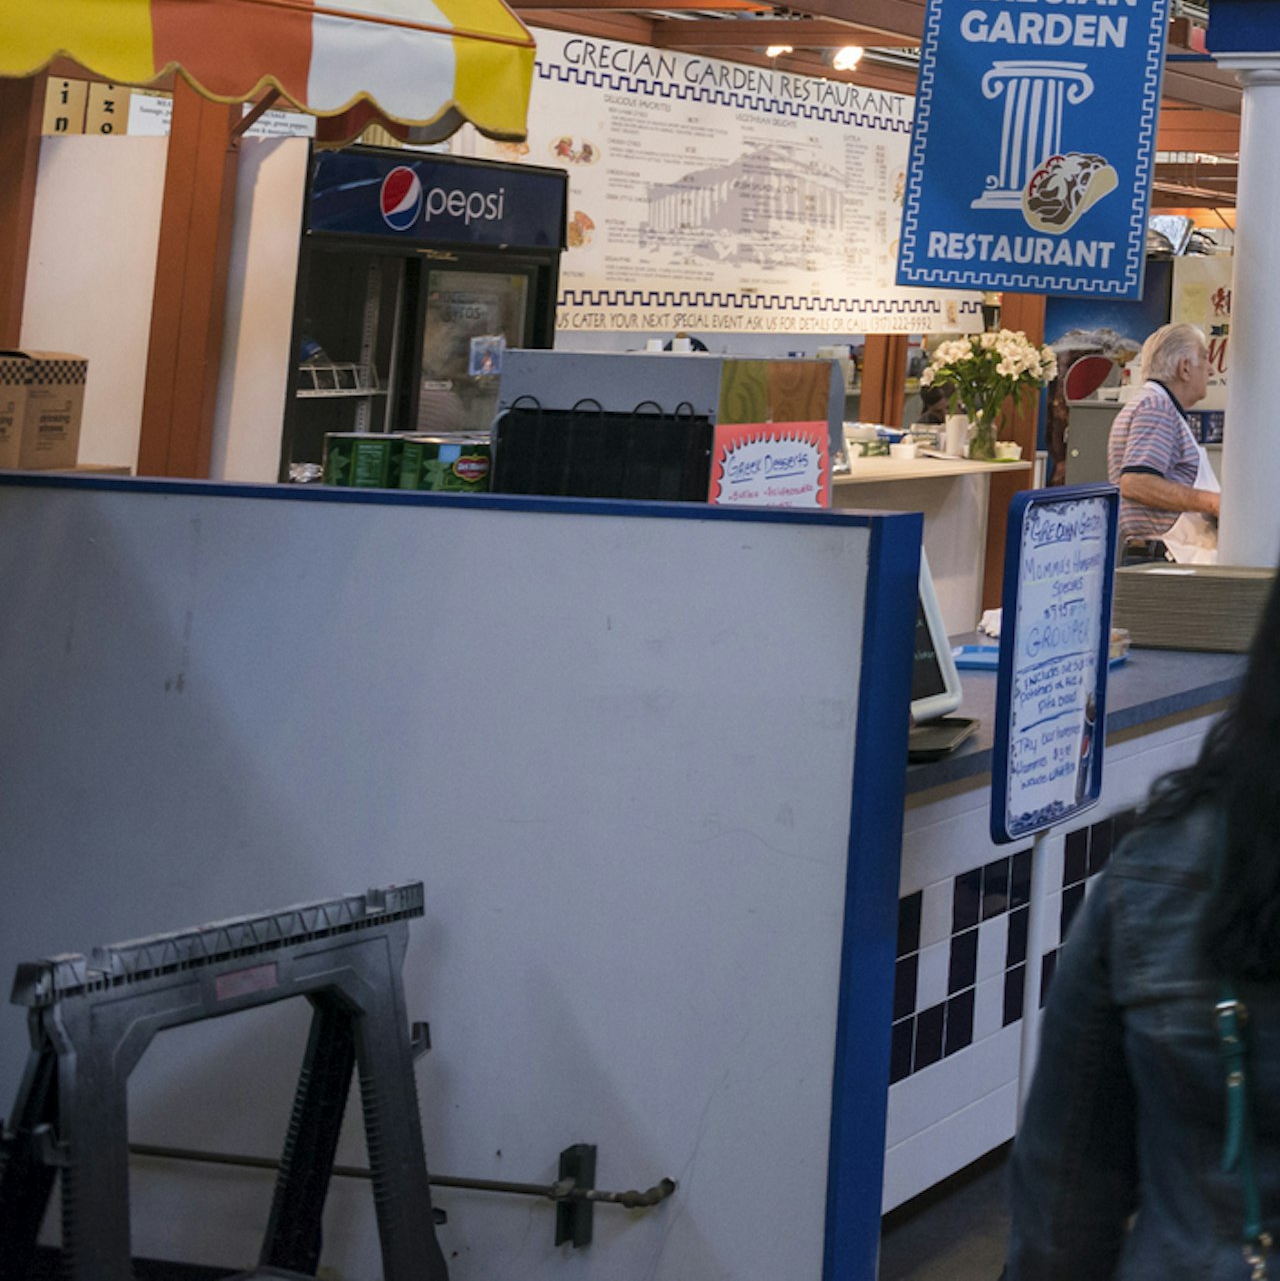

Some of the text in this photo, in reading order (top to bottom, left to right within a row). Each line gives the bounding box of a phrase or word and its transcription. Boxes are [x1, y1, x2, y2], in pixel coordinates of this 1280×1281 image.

[959, 10, 1129, 48] GARDEN
[562, 37, 906, 116] GRECIAN GARDEN RESTAURANT
[424, 187, 505, 225] pepsi
[927, 231, 1116, 269] RESTAURANT
[573, 312, 607, 329] CATER
[609, 312, 639, 329] YOUR
[641, 312, 670, 329] NEXT
[672, 313, 710, 330] SPECIAL
[712, 313, 744, 330] EVENT
[779, 316, 797, 331] FOR
